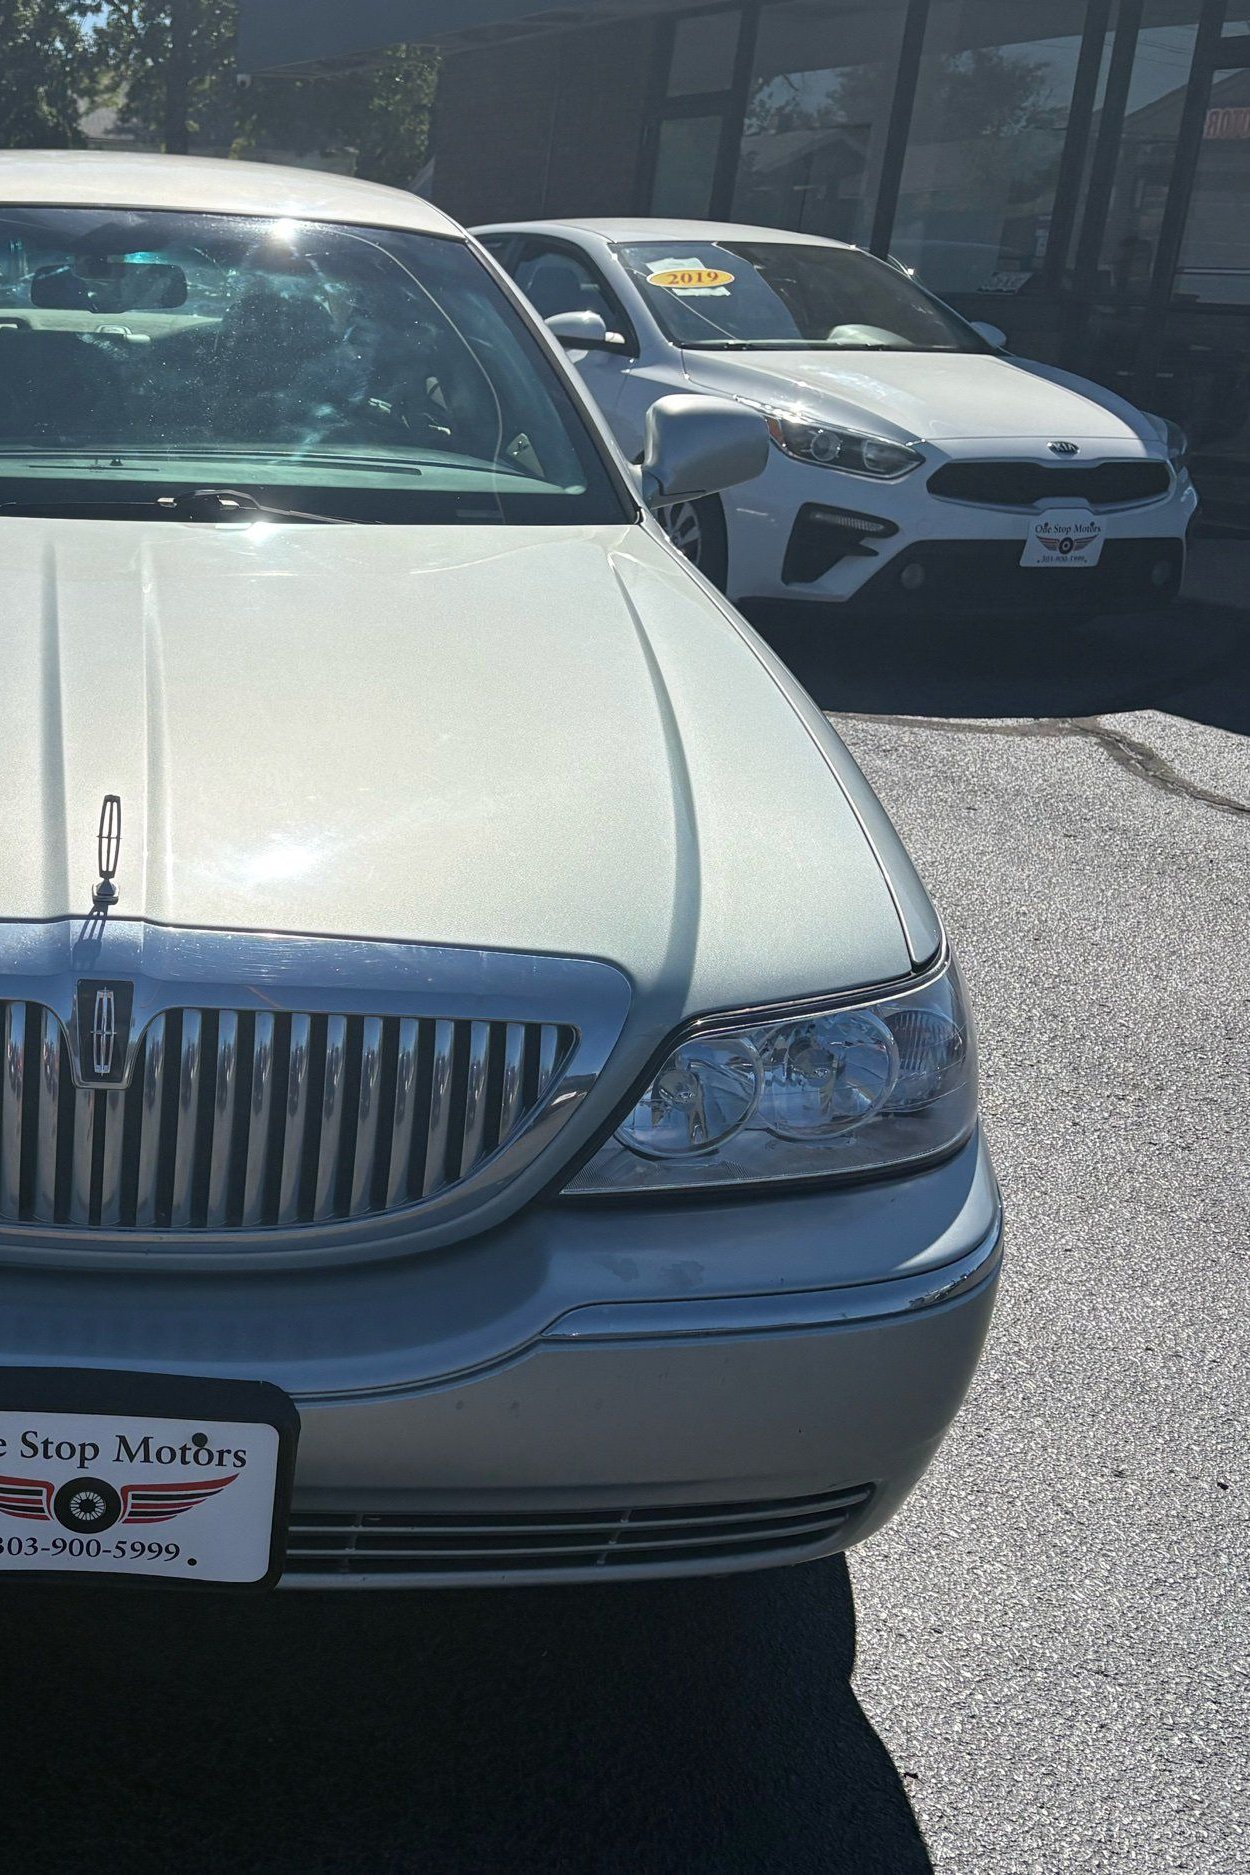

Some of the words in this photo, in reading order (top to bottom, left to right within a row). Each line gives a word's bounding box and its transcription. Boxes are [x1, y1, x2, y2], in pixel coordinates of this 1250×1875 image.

[669, 272, 718, 285] 2019
[1035, 524, 1051, 534] One
[1053, 523, 1071, 535] Stop
[1074, 524, 1101, 533] Motors
[20, 1430, 100, 1469] Stop
[112, 1434, 247, 1468] Motors
